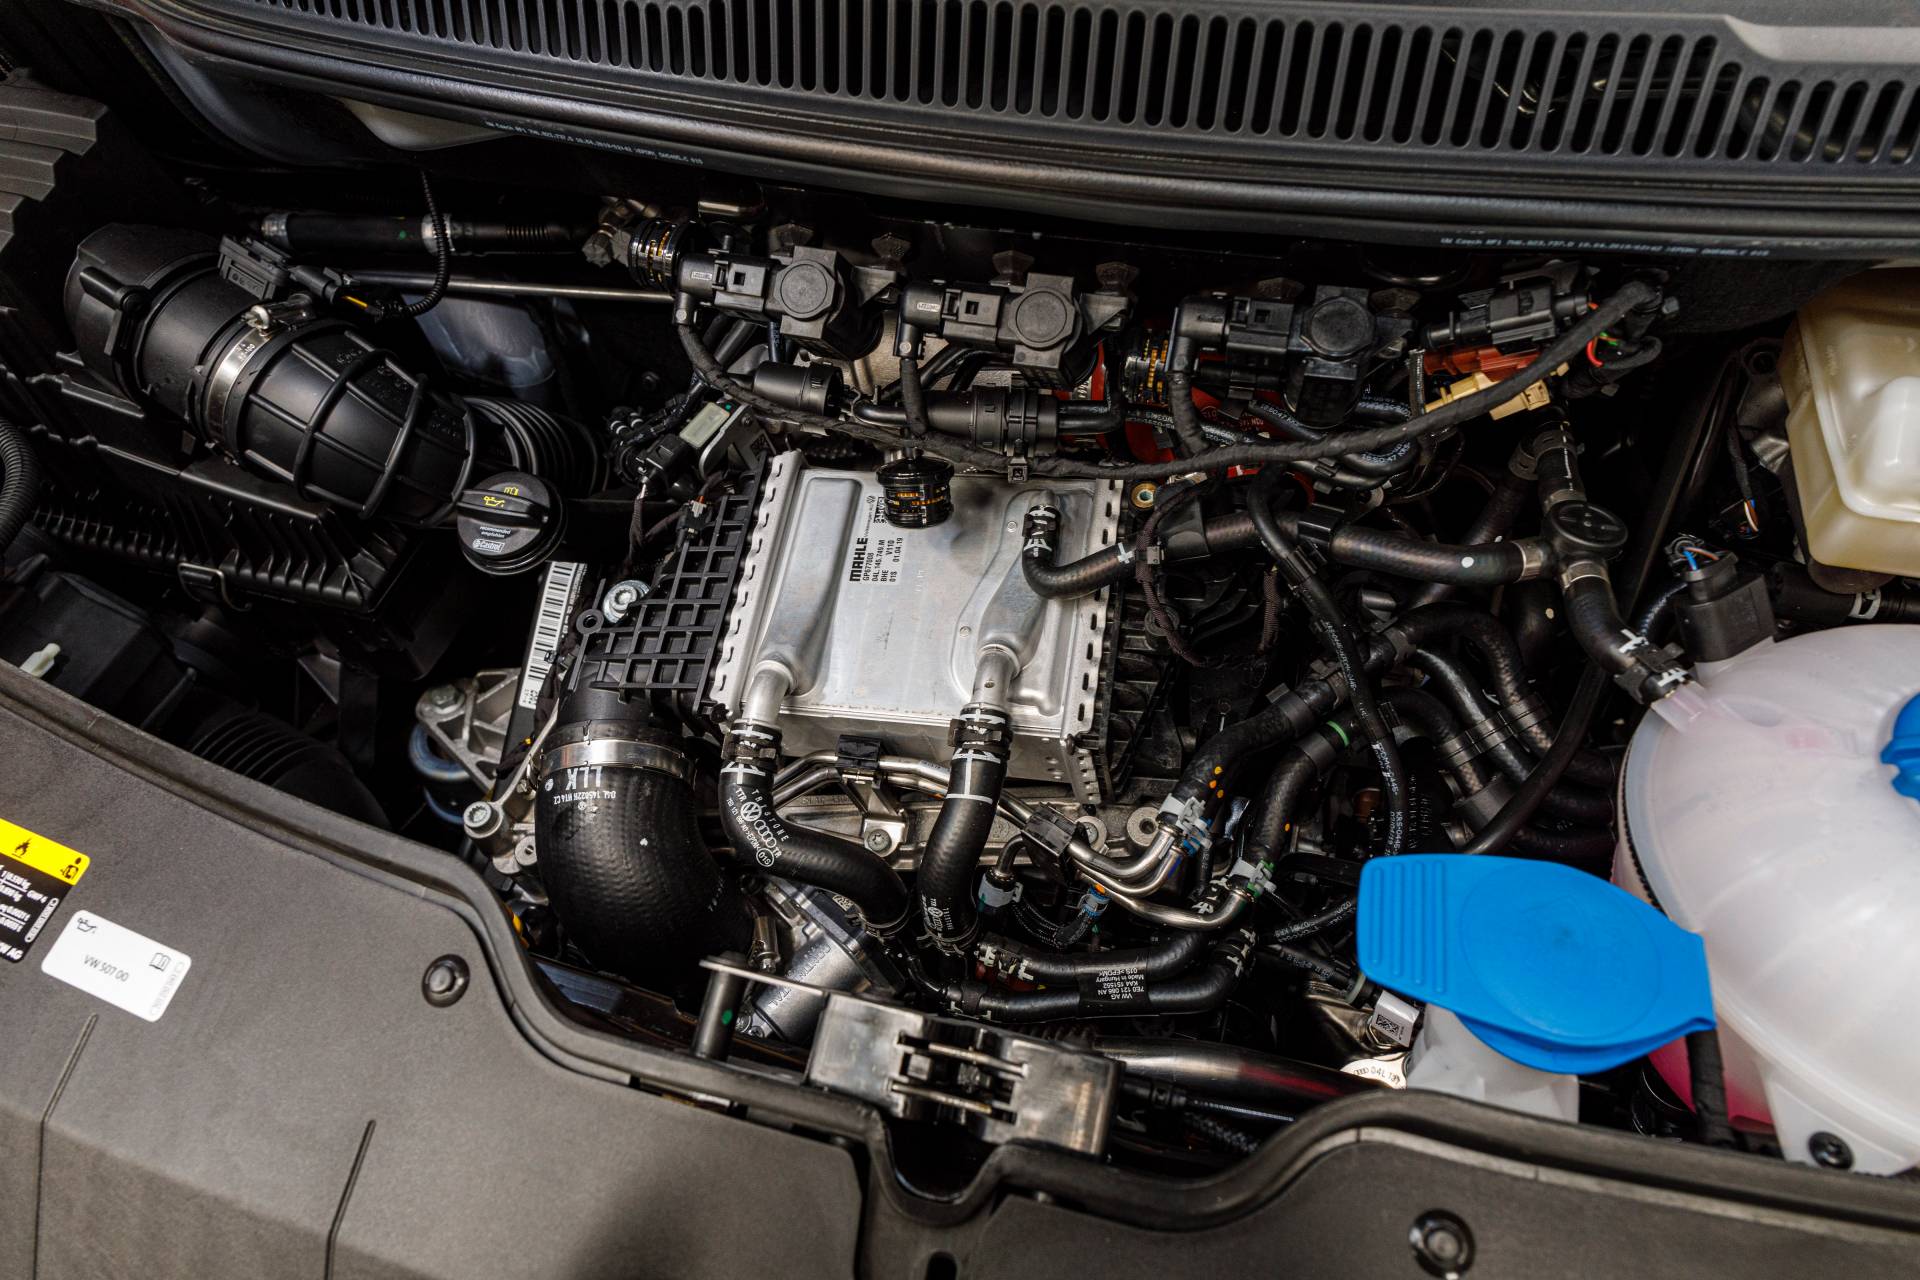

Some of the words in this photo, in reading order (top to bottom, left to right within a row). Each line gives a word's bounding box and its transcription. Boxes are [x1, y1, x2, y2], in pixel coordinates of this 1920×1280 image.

[480, 526, 511, 535] recommended
[480, 540, 502, 551] Castrol
[849, 537, 868, 582] MAHLE
[880, 569, 889, 582] BHE
[565, 766, 602, 790] LLK
[735, 787, 748, 802] TTR
[771, 846, 782, 859] TR
[751, 788, 789, 842] TRISTONE
[6, 947, 24, 961] AG
[84, 954, 101, 969] VW
[99, 960, 117, 977] 507
[115, 969, 129, 983] 00
